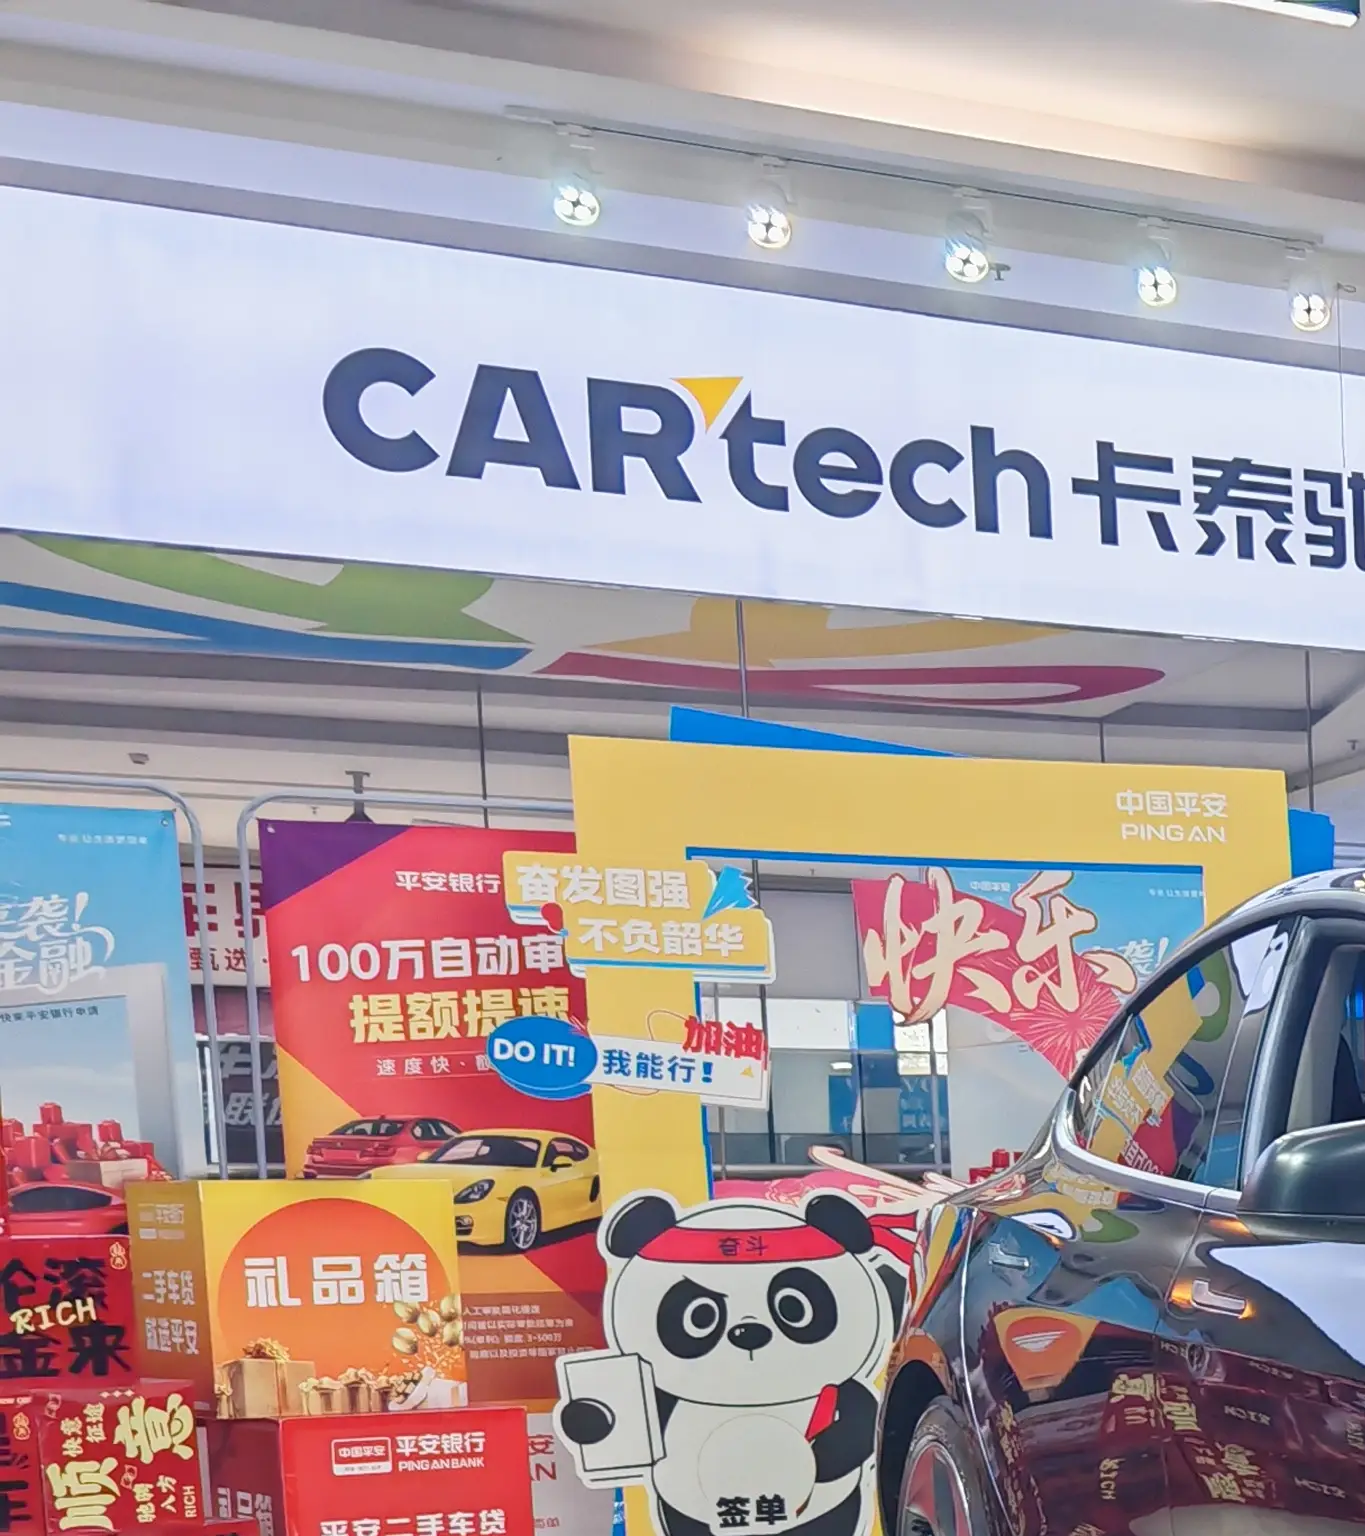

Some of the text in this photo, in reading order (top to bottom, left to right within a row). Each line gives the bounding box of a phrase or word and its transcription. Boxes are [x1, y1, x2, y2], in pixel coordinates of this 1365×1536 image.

[323, 346, 1054, 540] CARtech
[1115, 788, 1229, 819] 中国平安
[395, 870, 501, 893] 平安银行
[516, 864, 690, 909] 奋发图强
[291, 934, 565, 982] 100万自动审
[578, 917, 745, 958] 不负韶华
[863, 867, 1140, 1027] 快乐
[349, 985, 570, 1044] 提额提速
[494, 1038, 576, 1068] DO IT!
[682, 1015, 766, 1061] 加油
[717, 1236, 769, 1257] 奋斗
[243, 1253, 430, 1309] 礼品箱
[9, 1296, 98, 1335] RICH
[113, 1392, 196, 1464] 意
[394, 1431, 486, 1457] 平安银行
[338, 1445, 386, 1459] 中国平安
[46, 1457, 121, 1532] 顺
[183, 1484, 198, 1518] RICH
[716, 1494, 789, 1529] 签单
